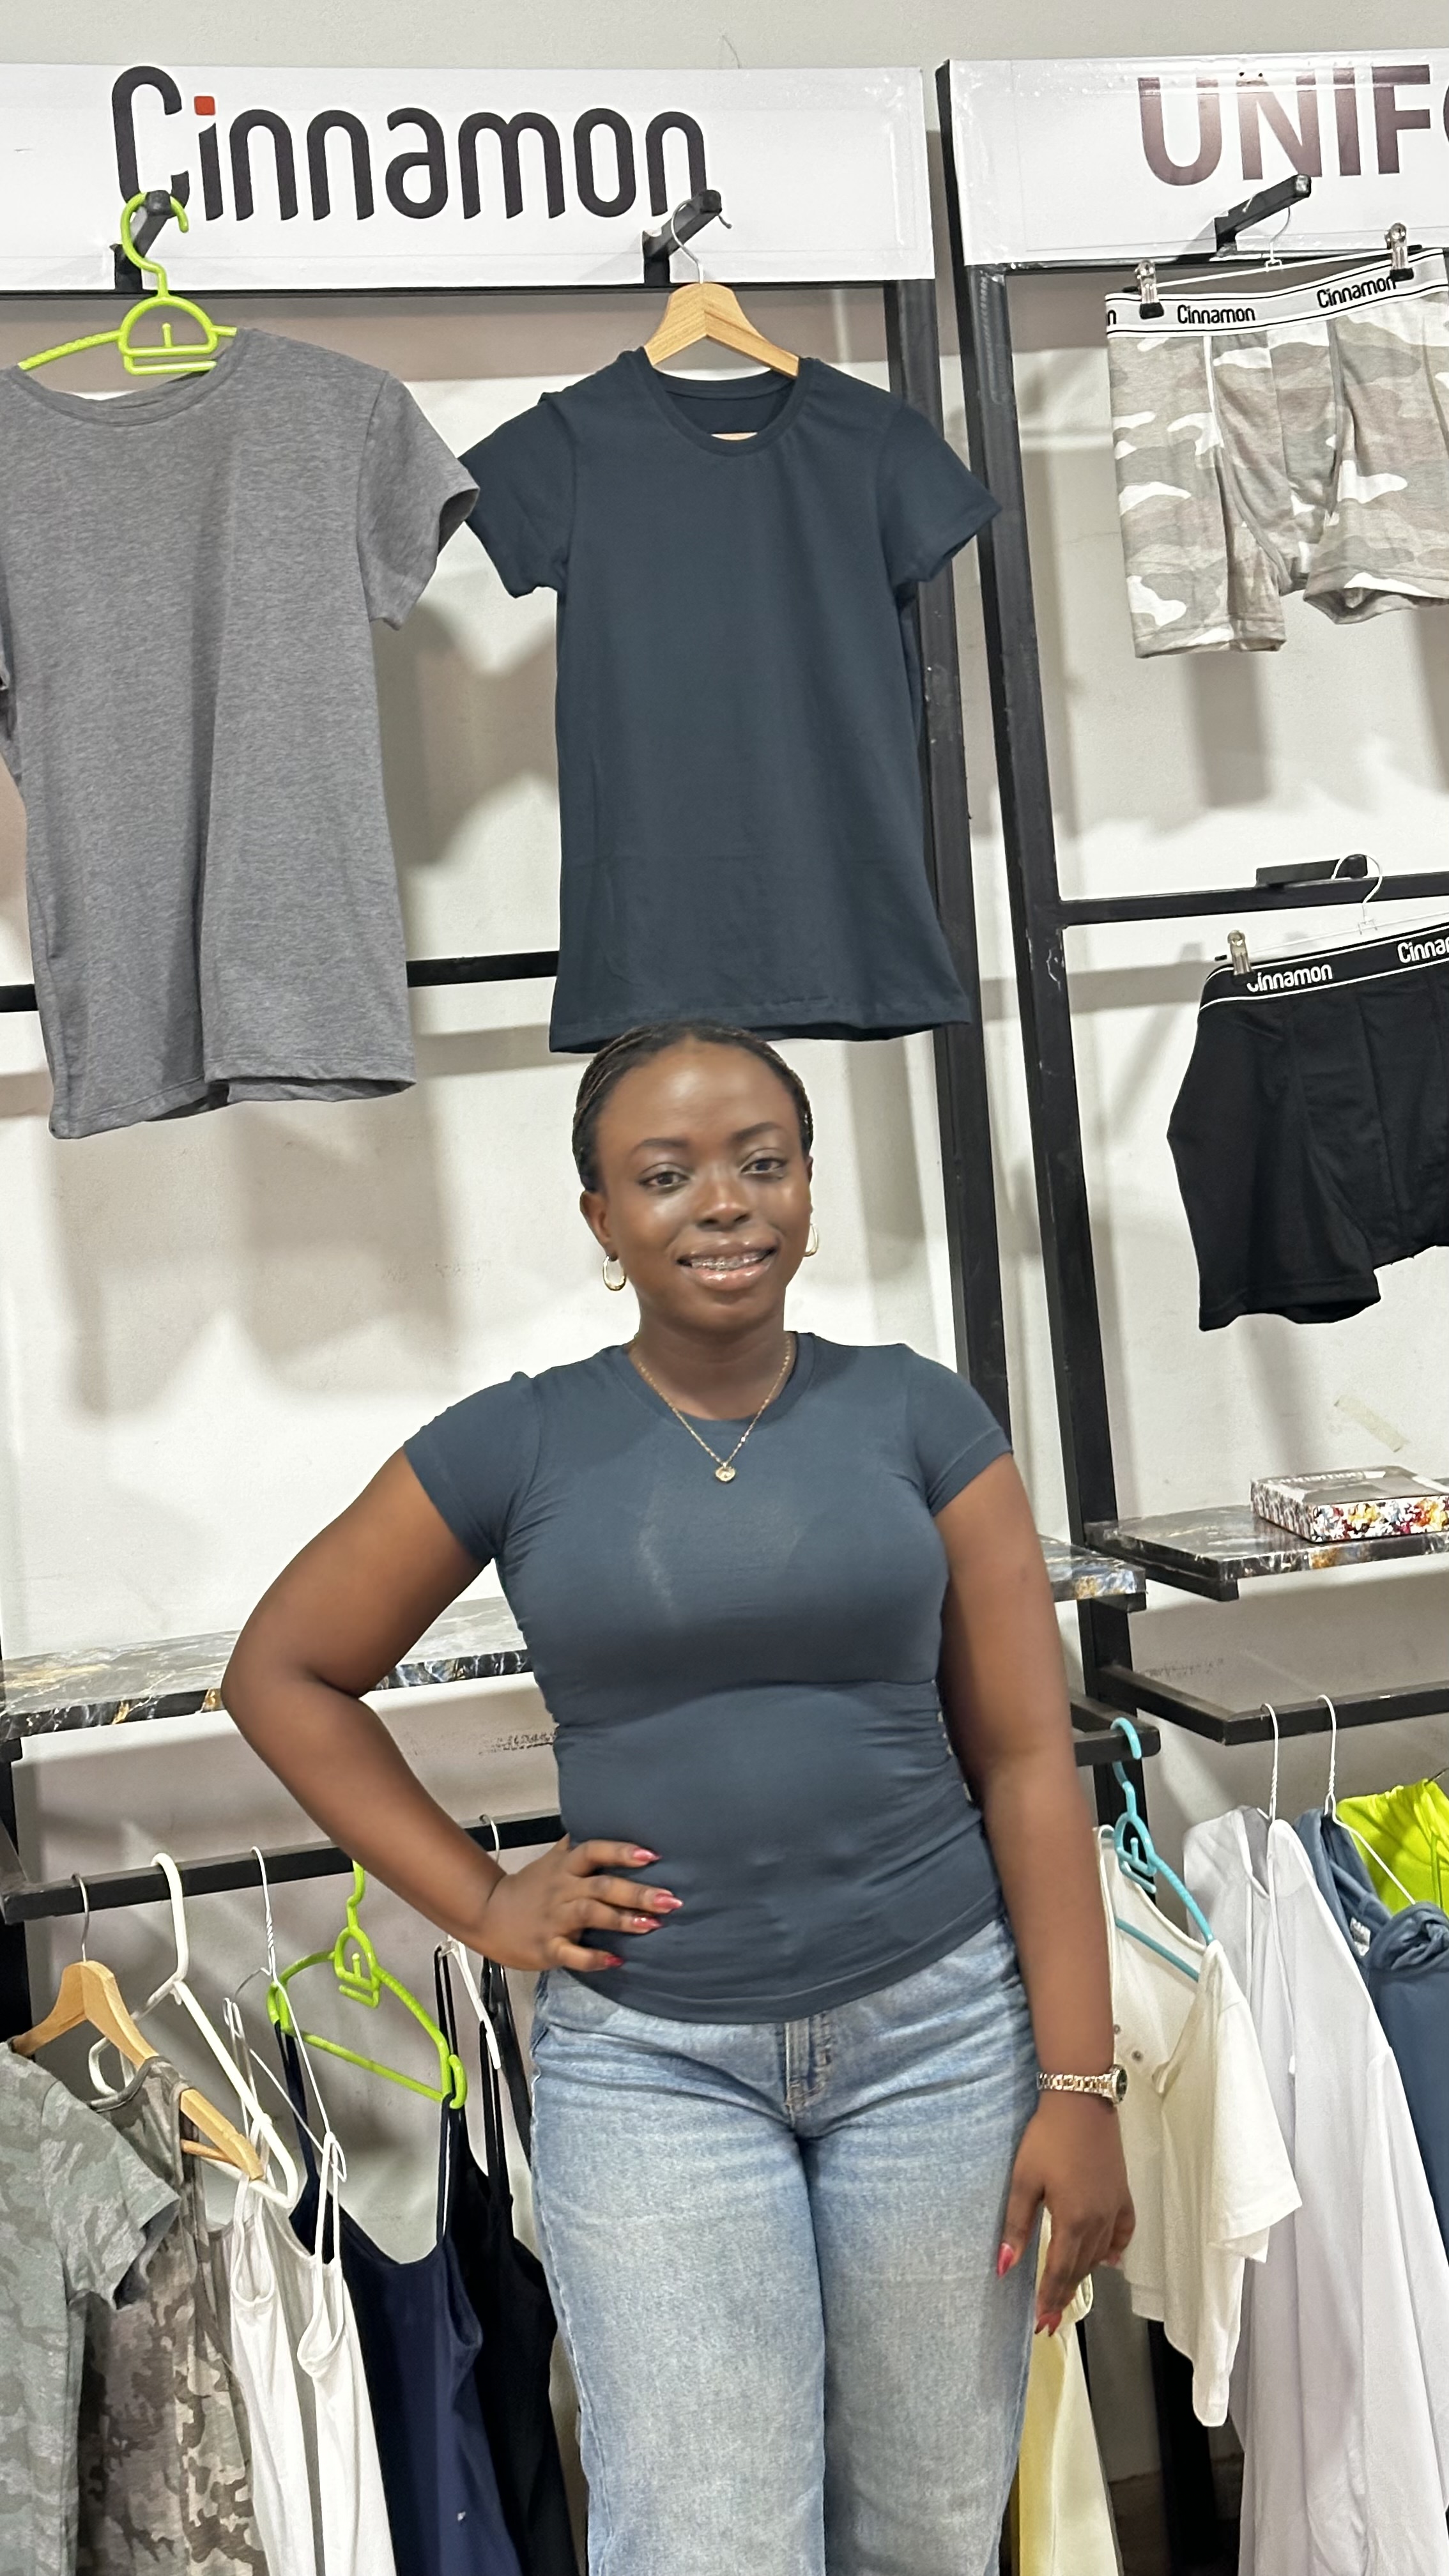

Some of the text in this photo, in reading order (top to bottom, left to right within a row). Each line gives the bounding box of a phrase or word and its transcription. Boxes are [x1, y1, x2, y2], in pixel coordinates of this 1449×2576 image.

[112, 66, 707, 220] Cinnamon
[1138, 64, 1449, 186] UNIF
[1177, 304, 1256, 325] Cinnamon
[1317, 276, 1397, 308] Cinnamon
[1397, 937, 1449, 963] Cinna
